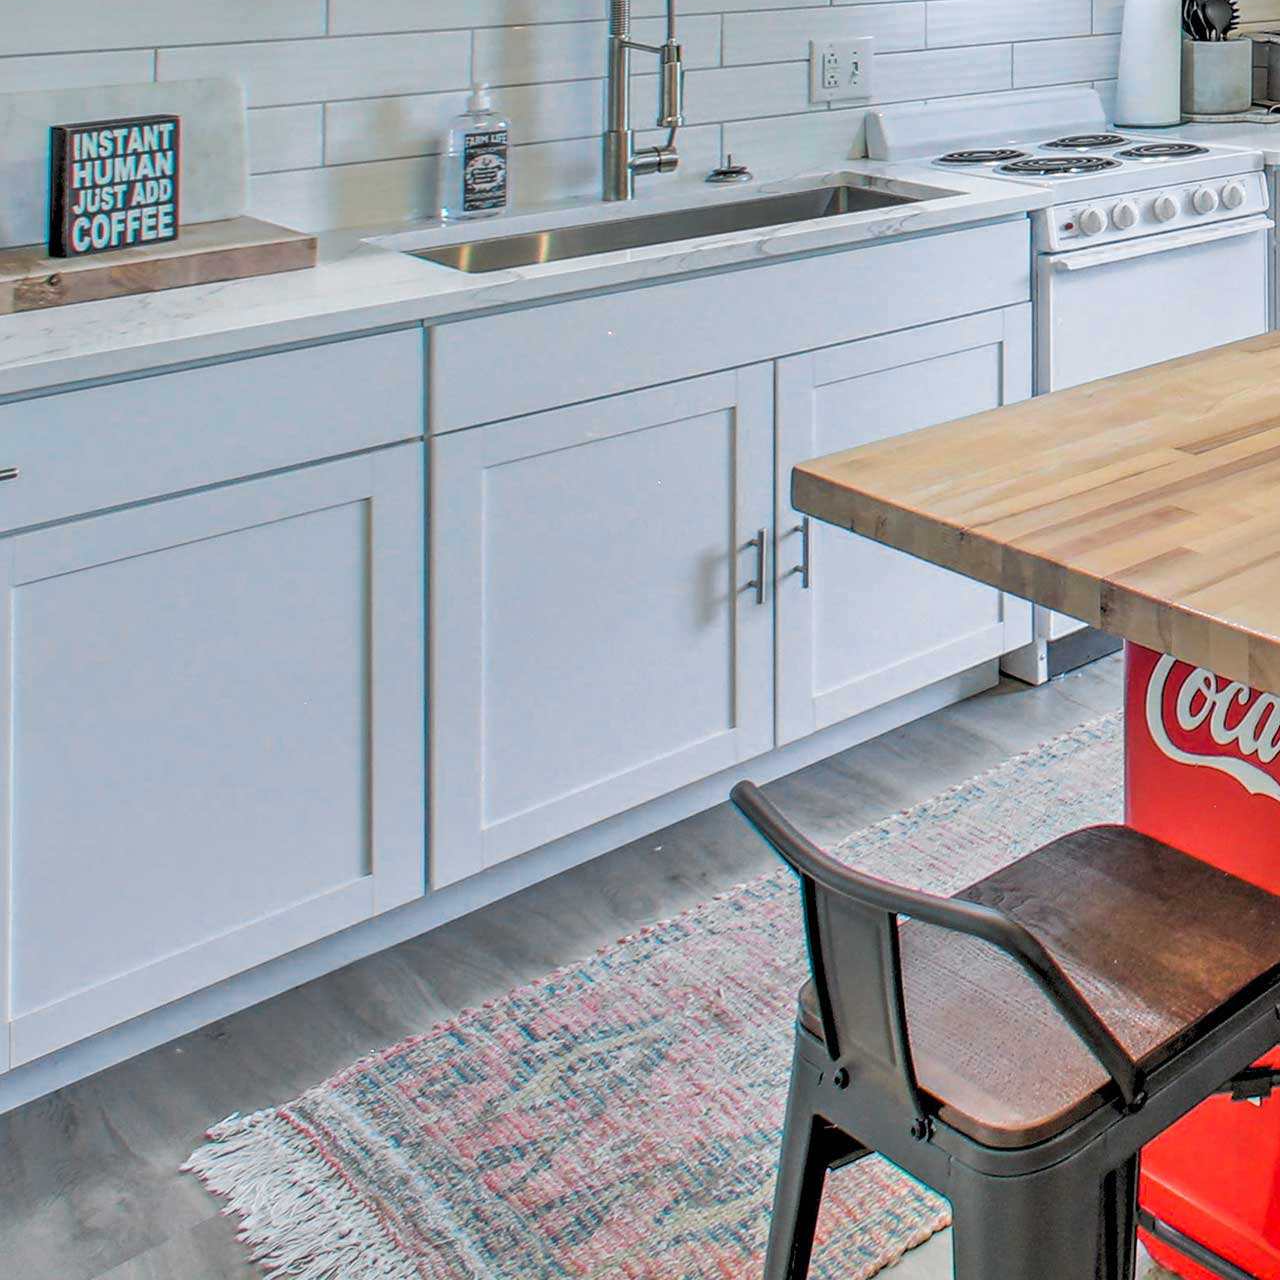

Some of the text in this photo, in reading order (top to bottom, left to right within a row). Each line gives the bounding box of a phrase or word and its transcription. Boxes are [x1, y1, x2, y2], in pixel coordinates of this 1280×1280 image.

[72, 123, 175, 161] INSTANT
[72, 150, 175, 189] HUMAN
[72, 178, 174, 215] JUST ADD
[72, 203, 175, 252] COFFEE
